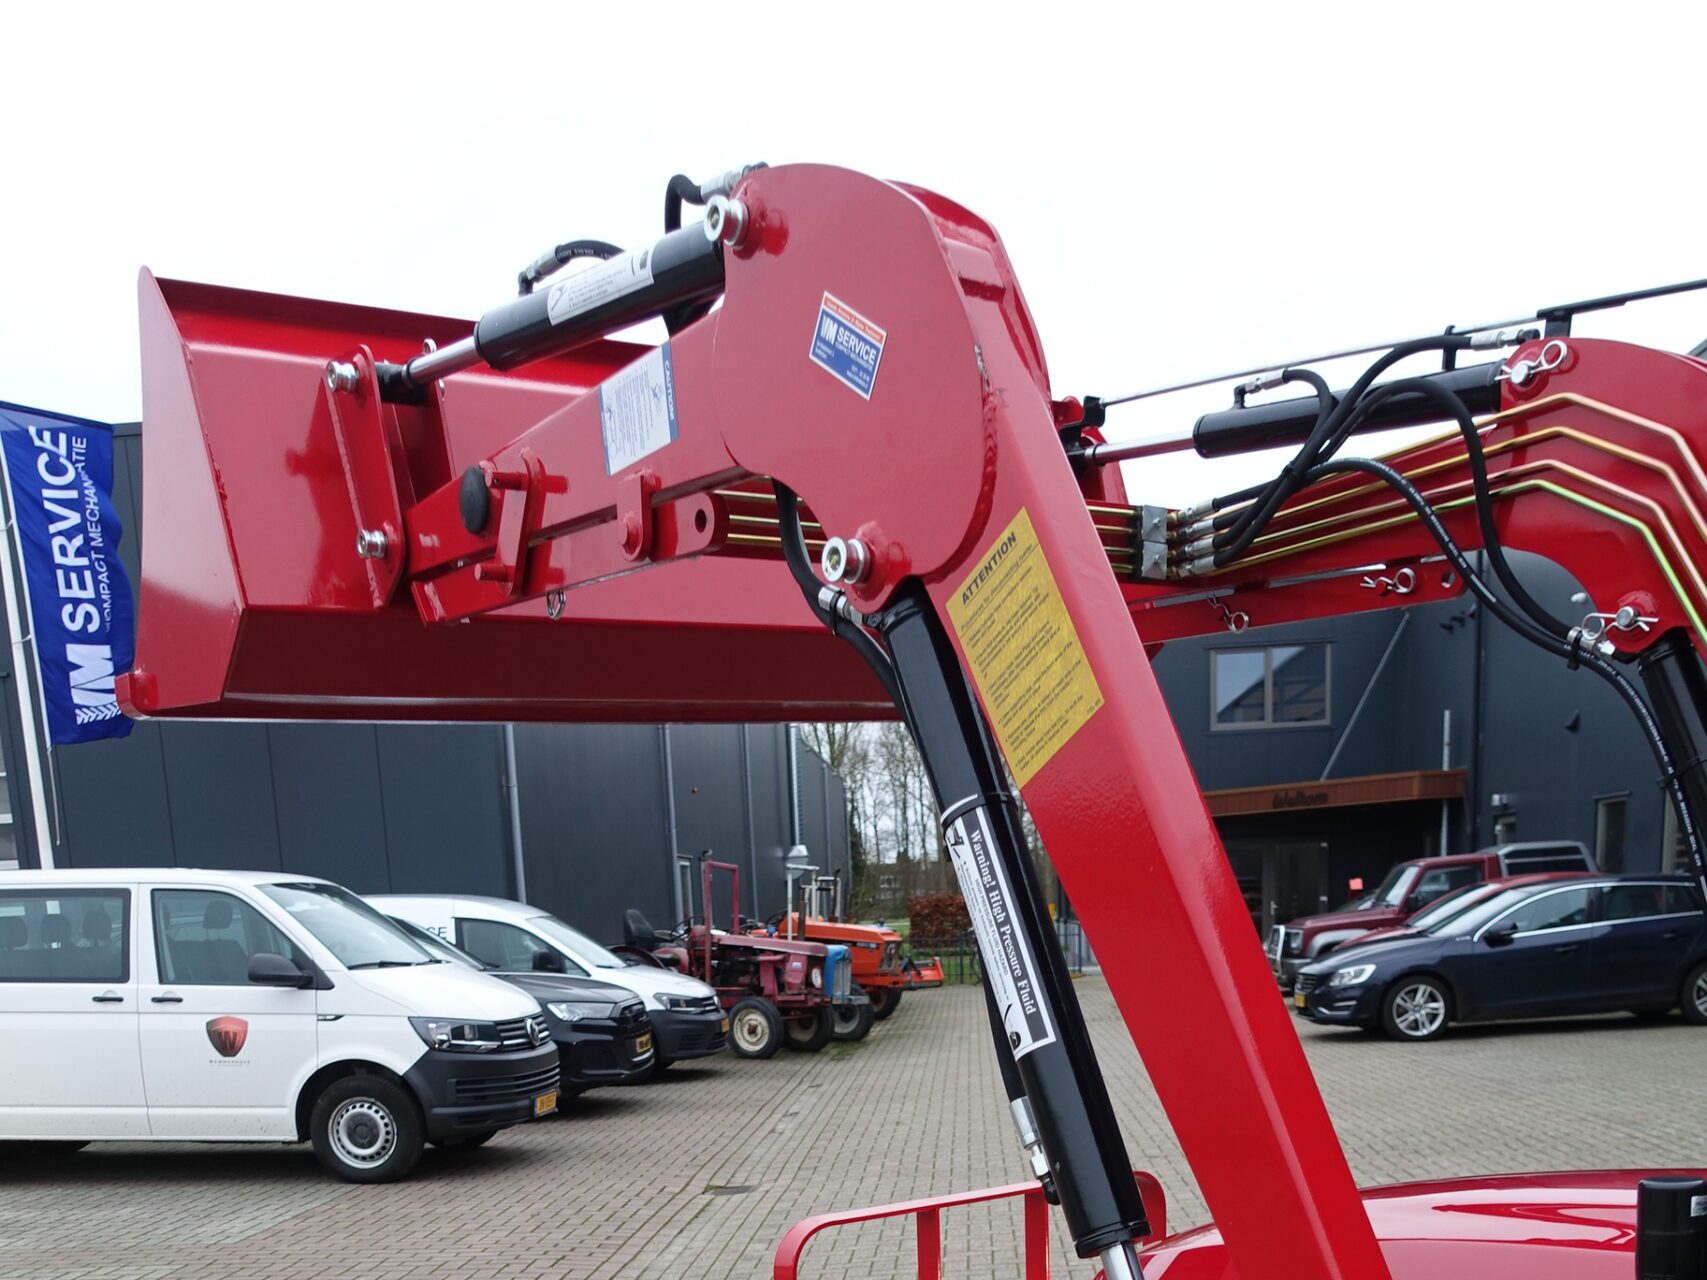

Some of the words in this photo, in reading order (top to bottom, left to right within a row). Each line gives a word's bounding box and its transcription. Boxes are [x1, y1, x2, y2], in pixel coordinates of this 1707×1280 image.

[837, 327, 877, 365] SERVICE
[28, 425, 101, 634] SERVICE
[72, 436, 104, 547] MECHANATIE
[962, 531, 1017, 605] ATTENTION
[970, 829, 996, 888] Warning!
[988, 889, 1007, 923] High
[1000, 924, 1022, 977] Pressure
[1017, 979, 1036, 1015] Fluid
[975, 878, 984, 895] HIGH
[980, 894, 995, 928] PRESSURE
[990, 929, 1001, 948] FLUID
[996, 948, 1008, 975] HAZARD
